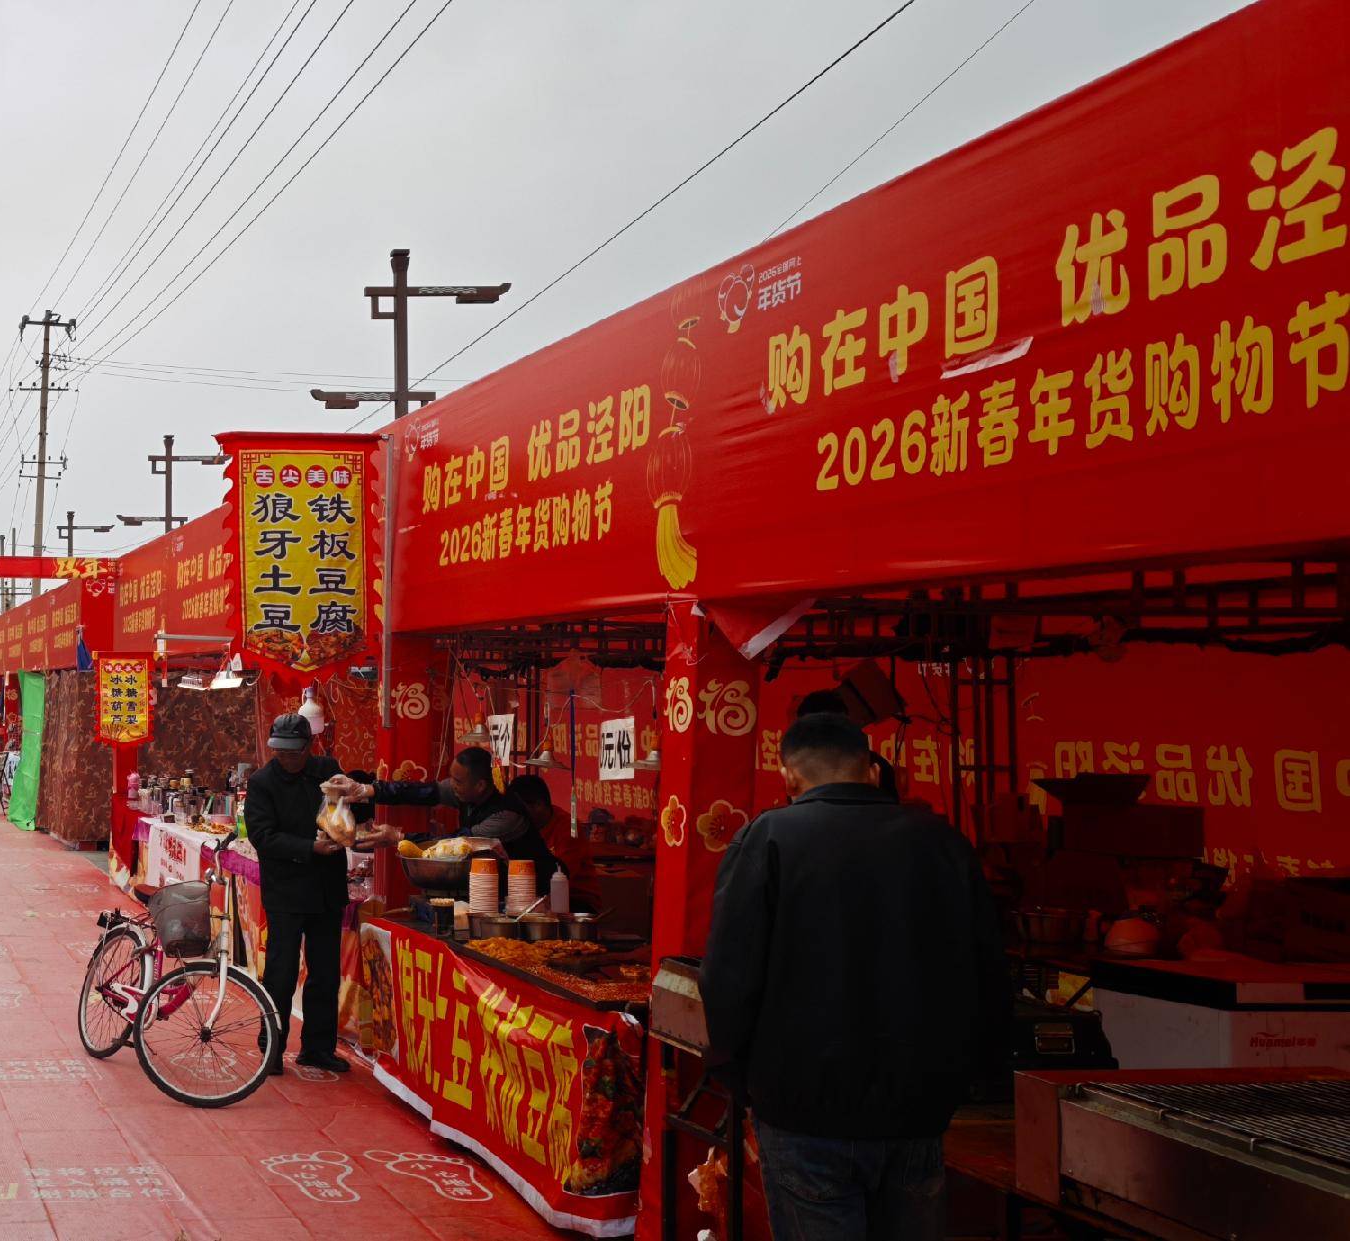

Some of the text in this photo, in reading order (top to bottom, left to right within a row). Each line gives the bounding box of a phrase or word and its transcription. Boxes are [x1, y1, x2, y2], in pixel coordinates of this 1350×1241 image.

[757, 272, 802, 311] 年货节
[768, 127, 1348, 414] 购在中国 优品泾
[422, 384, 651, 515] 购在中国 优品泾阳
[816, 291, 1350, 491] 2026新春年货购物节
[255, 468, 350, 486] 舌尖美味
[438, 481, 613, 568] 2026新春年货购物节
[250, 492, 302, 633] 狼牙土豆
[306, 492, 357, 634] 铁板豆腐
